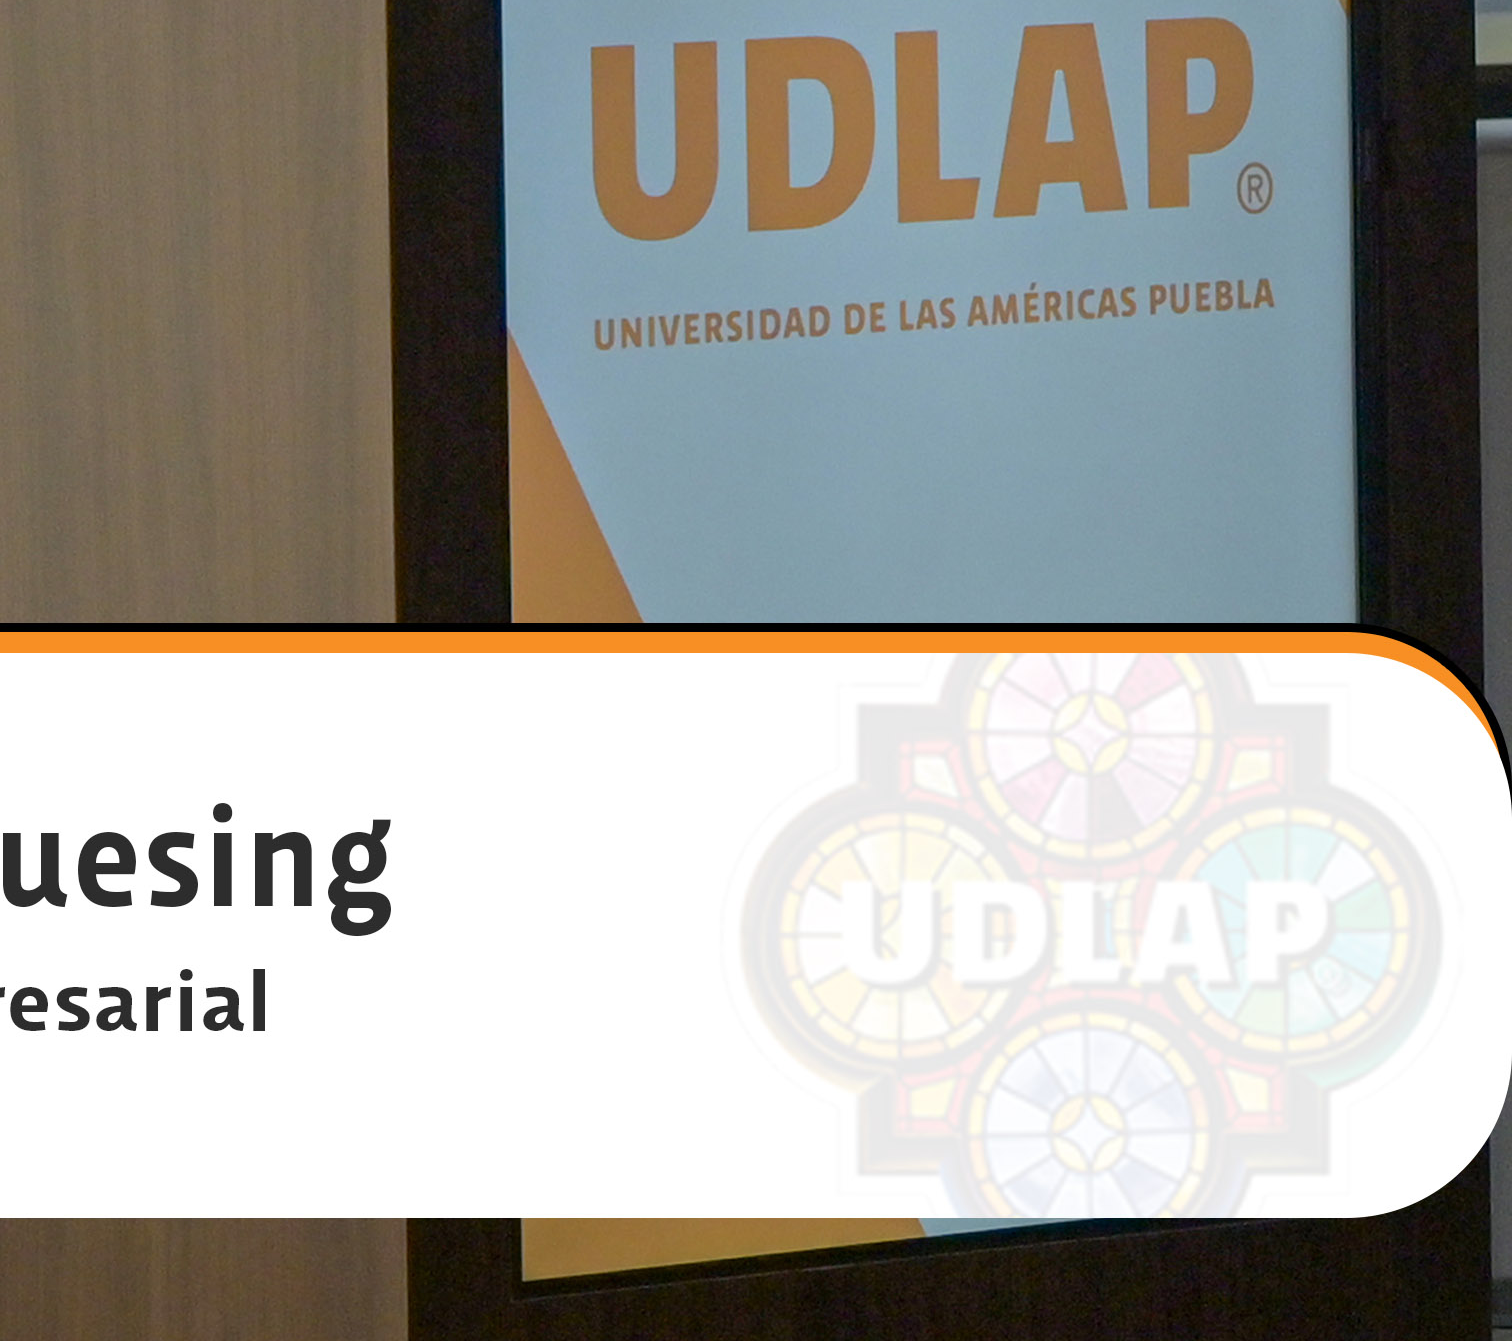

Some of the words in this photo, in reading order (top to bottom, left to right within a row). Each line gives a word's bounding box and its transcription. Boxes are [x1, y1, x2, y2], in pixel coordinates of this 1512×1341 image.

[590, 15, 1254, 243] UDLAP
[593, 303, 832, 353] UNIVERSIDAD
[842, 300, 888, 336] DE
[898, 296, 958, 333] LAS
[966, 281, 1138, 327] AMÉRICAS
[1147, 277, 1276, 315] PUEBLA
